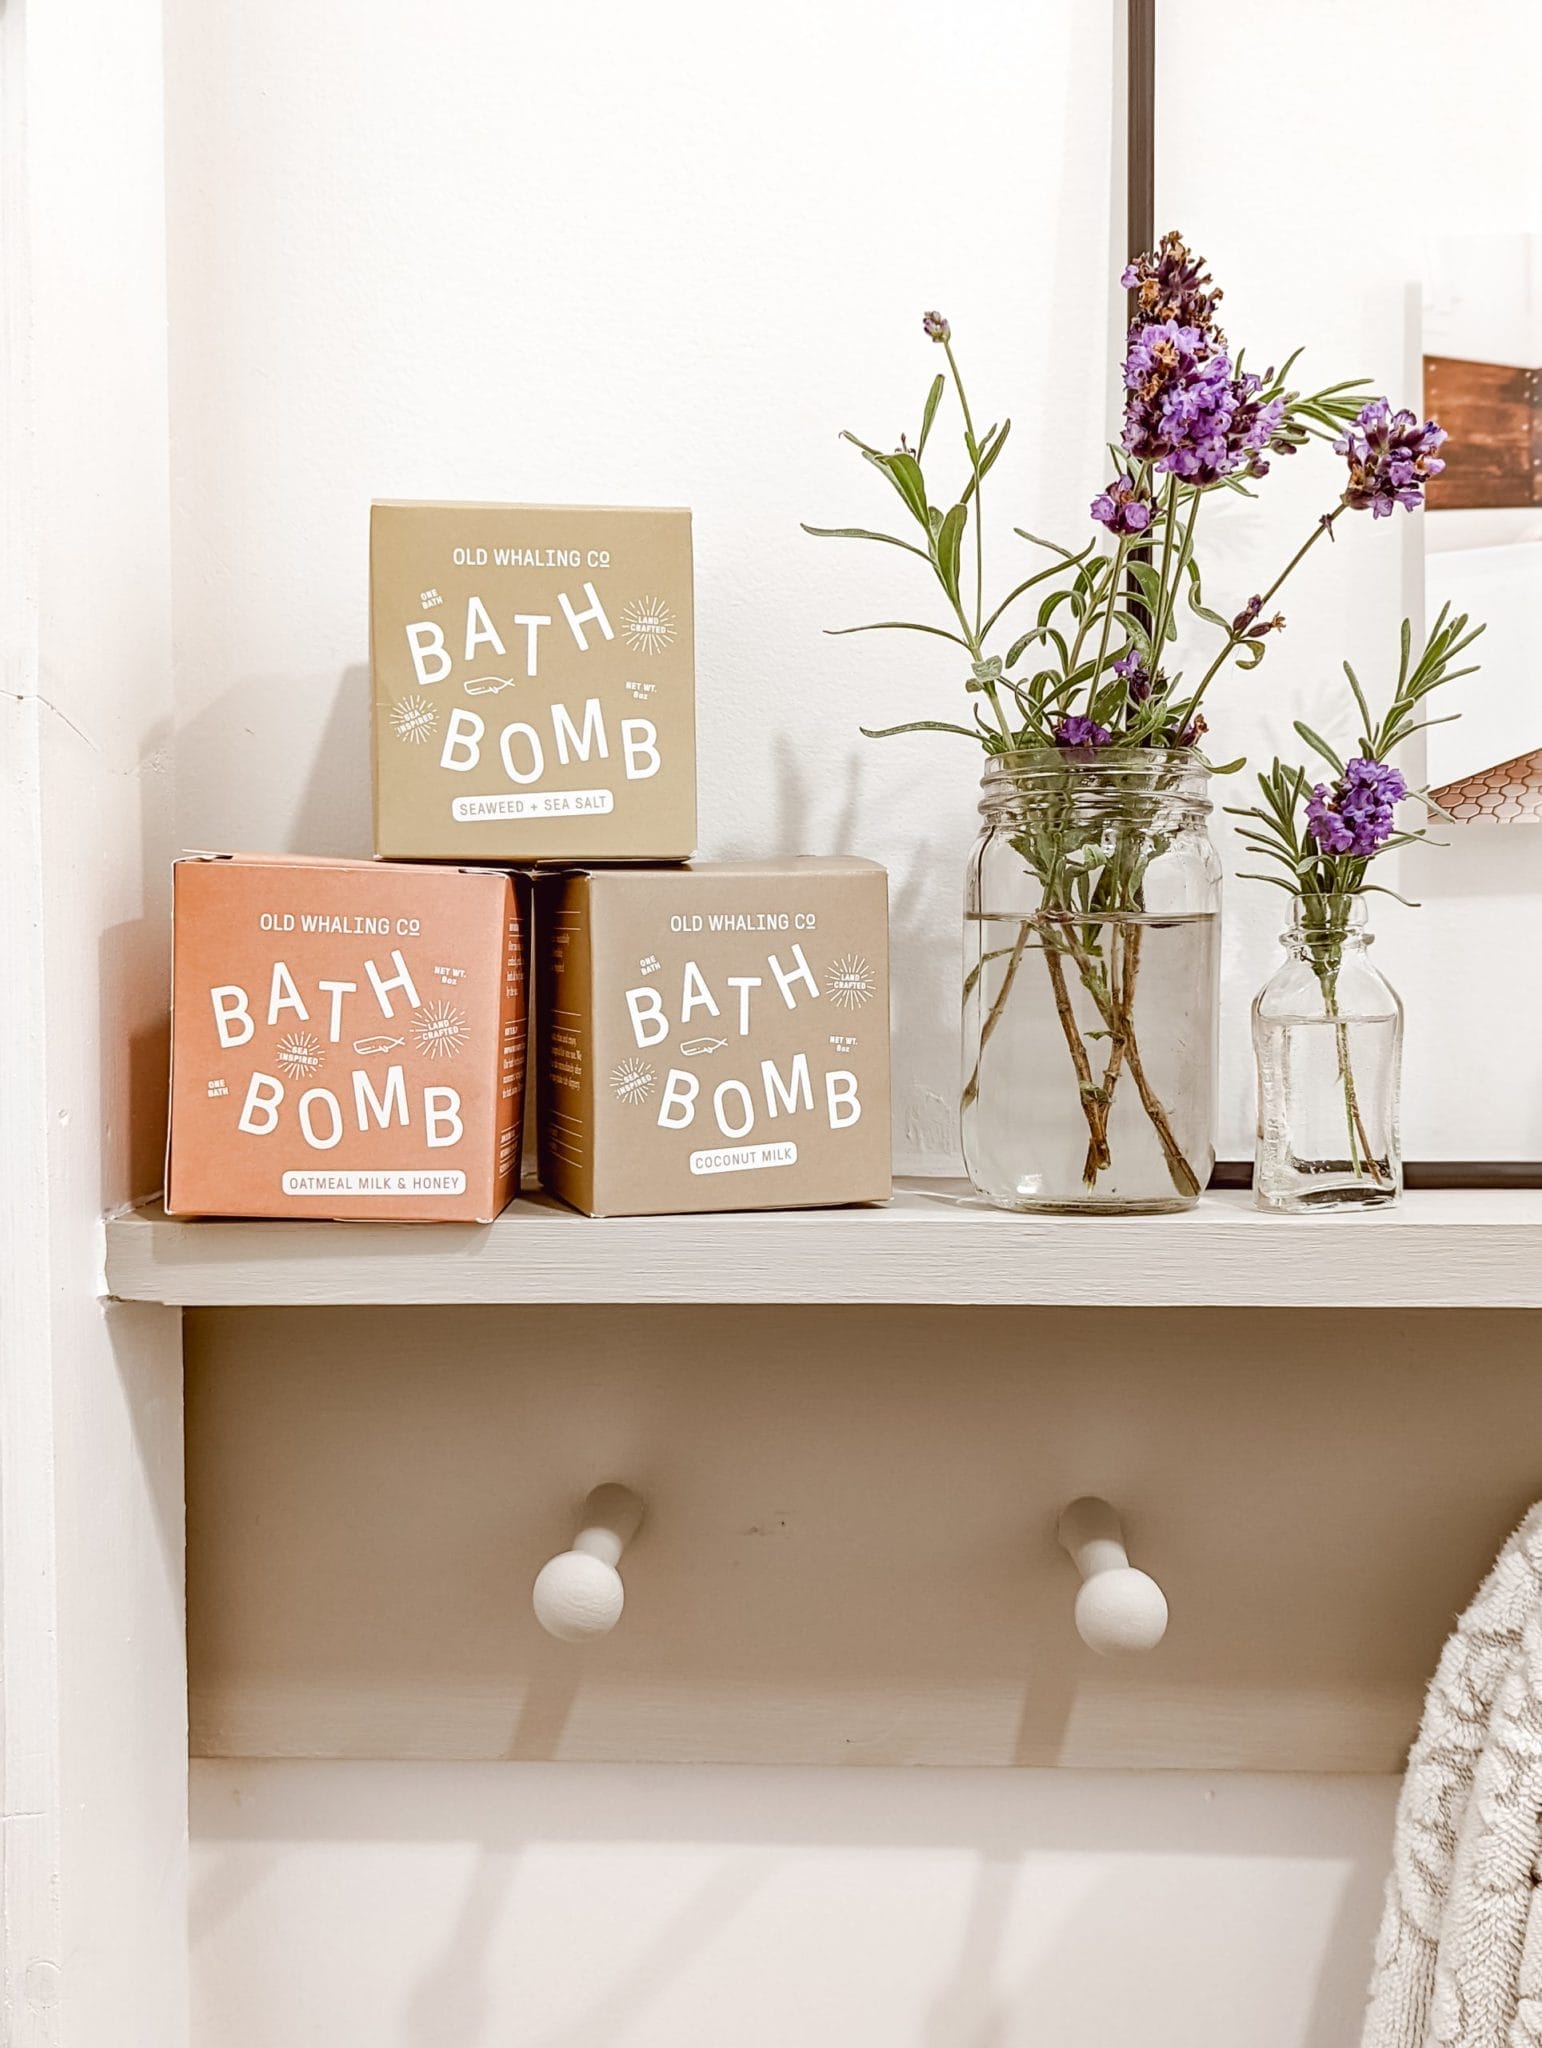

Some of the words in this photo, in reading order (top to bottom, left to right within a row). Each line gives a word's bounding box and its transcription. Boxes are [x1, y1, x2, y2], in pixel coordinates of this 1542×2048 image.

[453, 548, 488, 566] OLD
[494, 549, 581, 567] WHALING
[421, 589, 438, 602] ONE
[422, 595, 443, 610] BATH
[638, 616, 659, 625] LAND
[405, 581, 615, 685] BATH
[631, 624, 666, 634] CRAFTED
[625, 681, 641, 691] NET
[643, 682, 657, 693] WT.
[398, 712, 434, 733] INSPIRED
[403, 709, 421, 723] SEA
[441, 698, 662, 785] BOMB
[459, 800, 524, 816] SEAWEED
[531, 803, 538, 811] +
[544, 798, 570, 811] SEA
[575, 796, 607, 809] SALT
[260, 914, 294, 932] OLD
[301, 916, 390, 935] WHALING
[670, 915, 702, 932] OLD
[708, 914, 790, 931] WHALING
[640, 955, 657, 967] ONE
[434, 966, 451, 976] NET
[452, 967, 467, 978] WT.
[640, 962, 660, 976] BATH
[841, 973, 860, 982] LAND
[834, 981, 866, 990] CRAFTED
[210, 949, 421, 1049] BATH
[625, 943, 821, 1049] BATH
[428, 1019, 450, 1030] LAND
[422, 1025, 459, 1041] CRAFTED
[830, 1035, 843, 1044] NET
[845, 1036, 858, 1046] WT.
[292, 1046, 309, 1055] SEA
[279, 1052, 319, 1065] INSPIRED
[208, 1079, 226, 1088] ONE
[617, 1074, 652, 1096] INSPIRED
[623, 1072, 640, 1084] SEA
[208, 1087, 229, 1098] BATH
[657, 1053, 862, 1139] BOMB
[238, 1065, 464, 1151] BOMB
[695, 1152, 756, 1169] COCONUT
[762, 1147, 792, 1162] MILK
[289, 1176, 352, 1190] OATMEAL
[358, 1176, 391, 1190] MILK
[398, 1177, 406, 1189] &
[412, 1176, 459, 1190] HONEY
